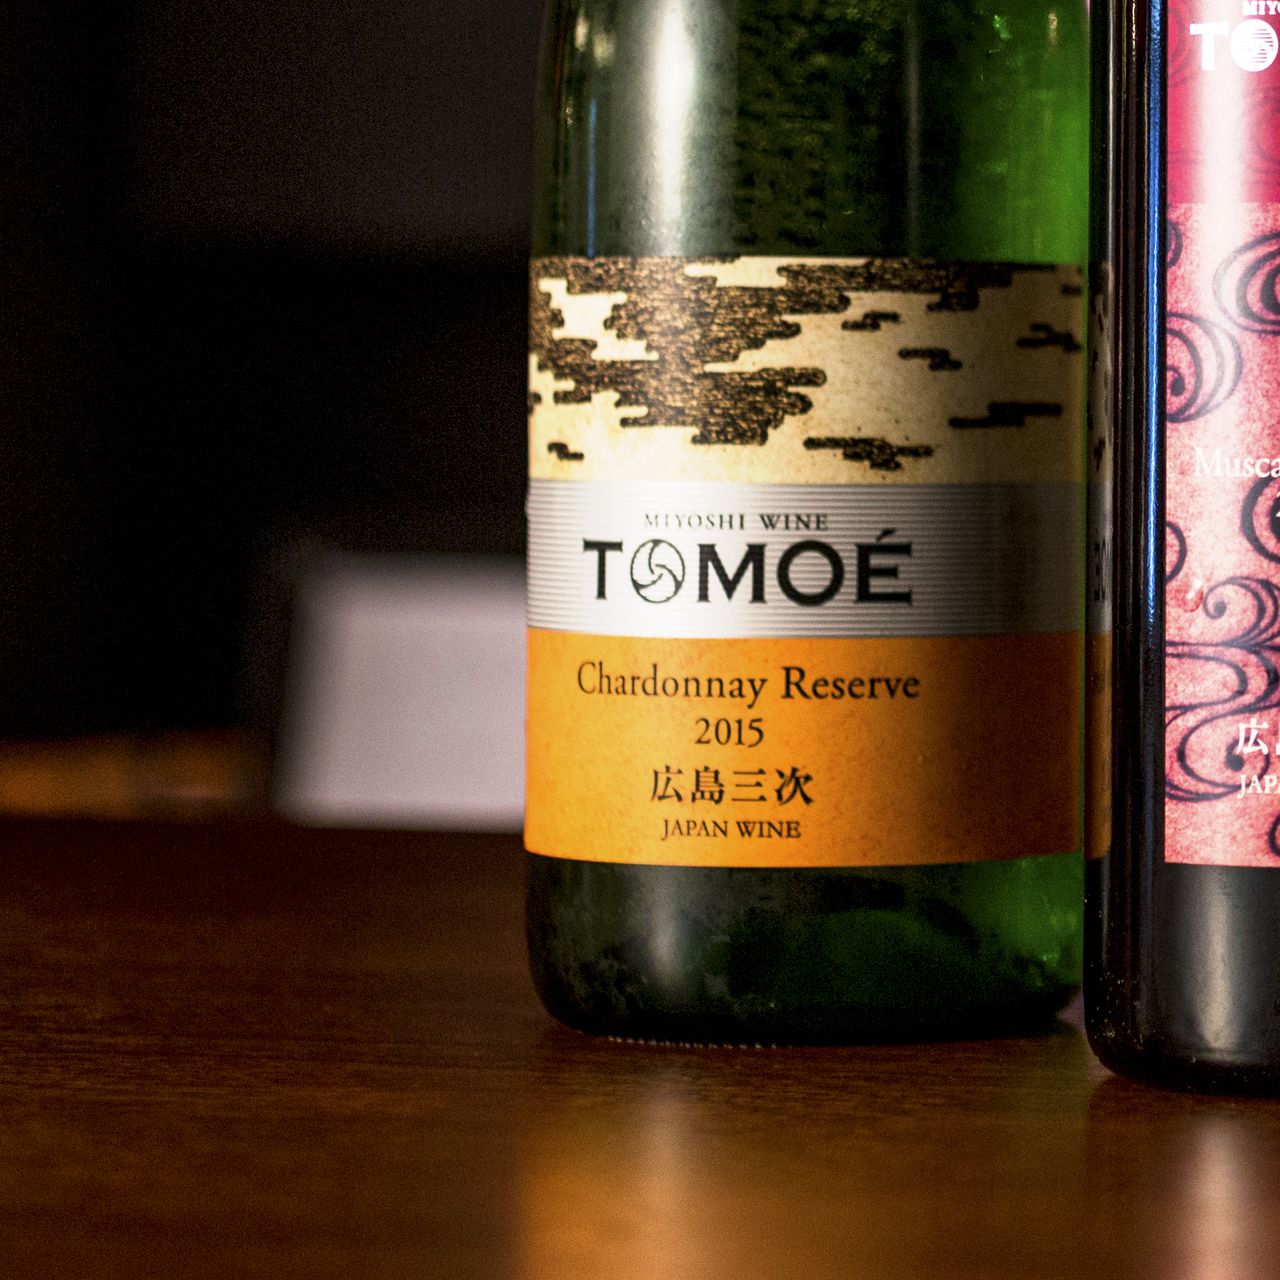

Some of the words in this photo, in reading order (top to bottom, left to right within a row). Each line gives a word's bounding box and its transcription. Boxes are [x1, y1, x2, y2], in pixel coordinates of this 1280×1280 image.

[644, 513, 745, 530] MIYOSHI
[759, 513, 829, 531] WINE
[582, 528, 913, 607] TOMOÉ
[577, 661, 768, 709] Chardonnay
[781, 666, 921, 700] Reserve
[694, 718, 765, 748] 2015
[650, 765, 814, 806] 広島三次
[661, 819, 728, 841] JAPAN
[736, 820, 802, 839] WINE
